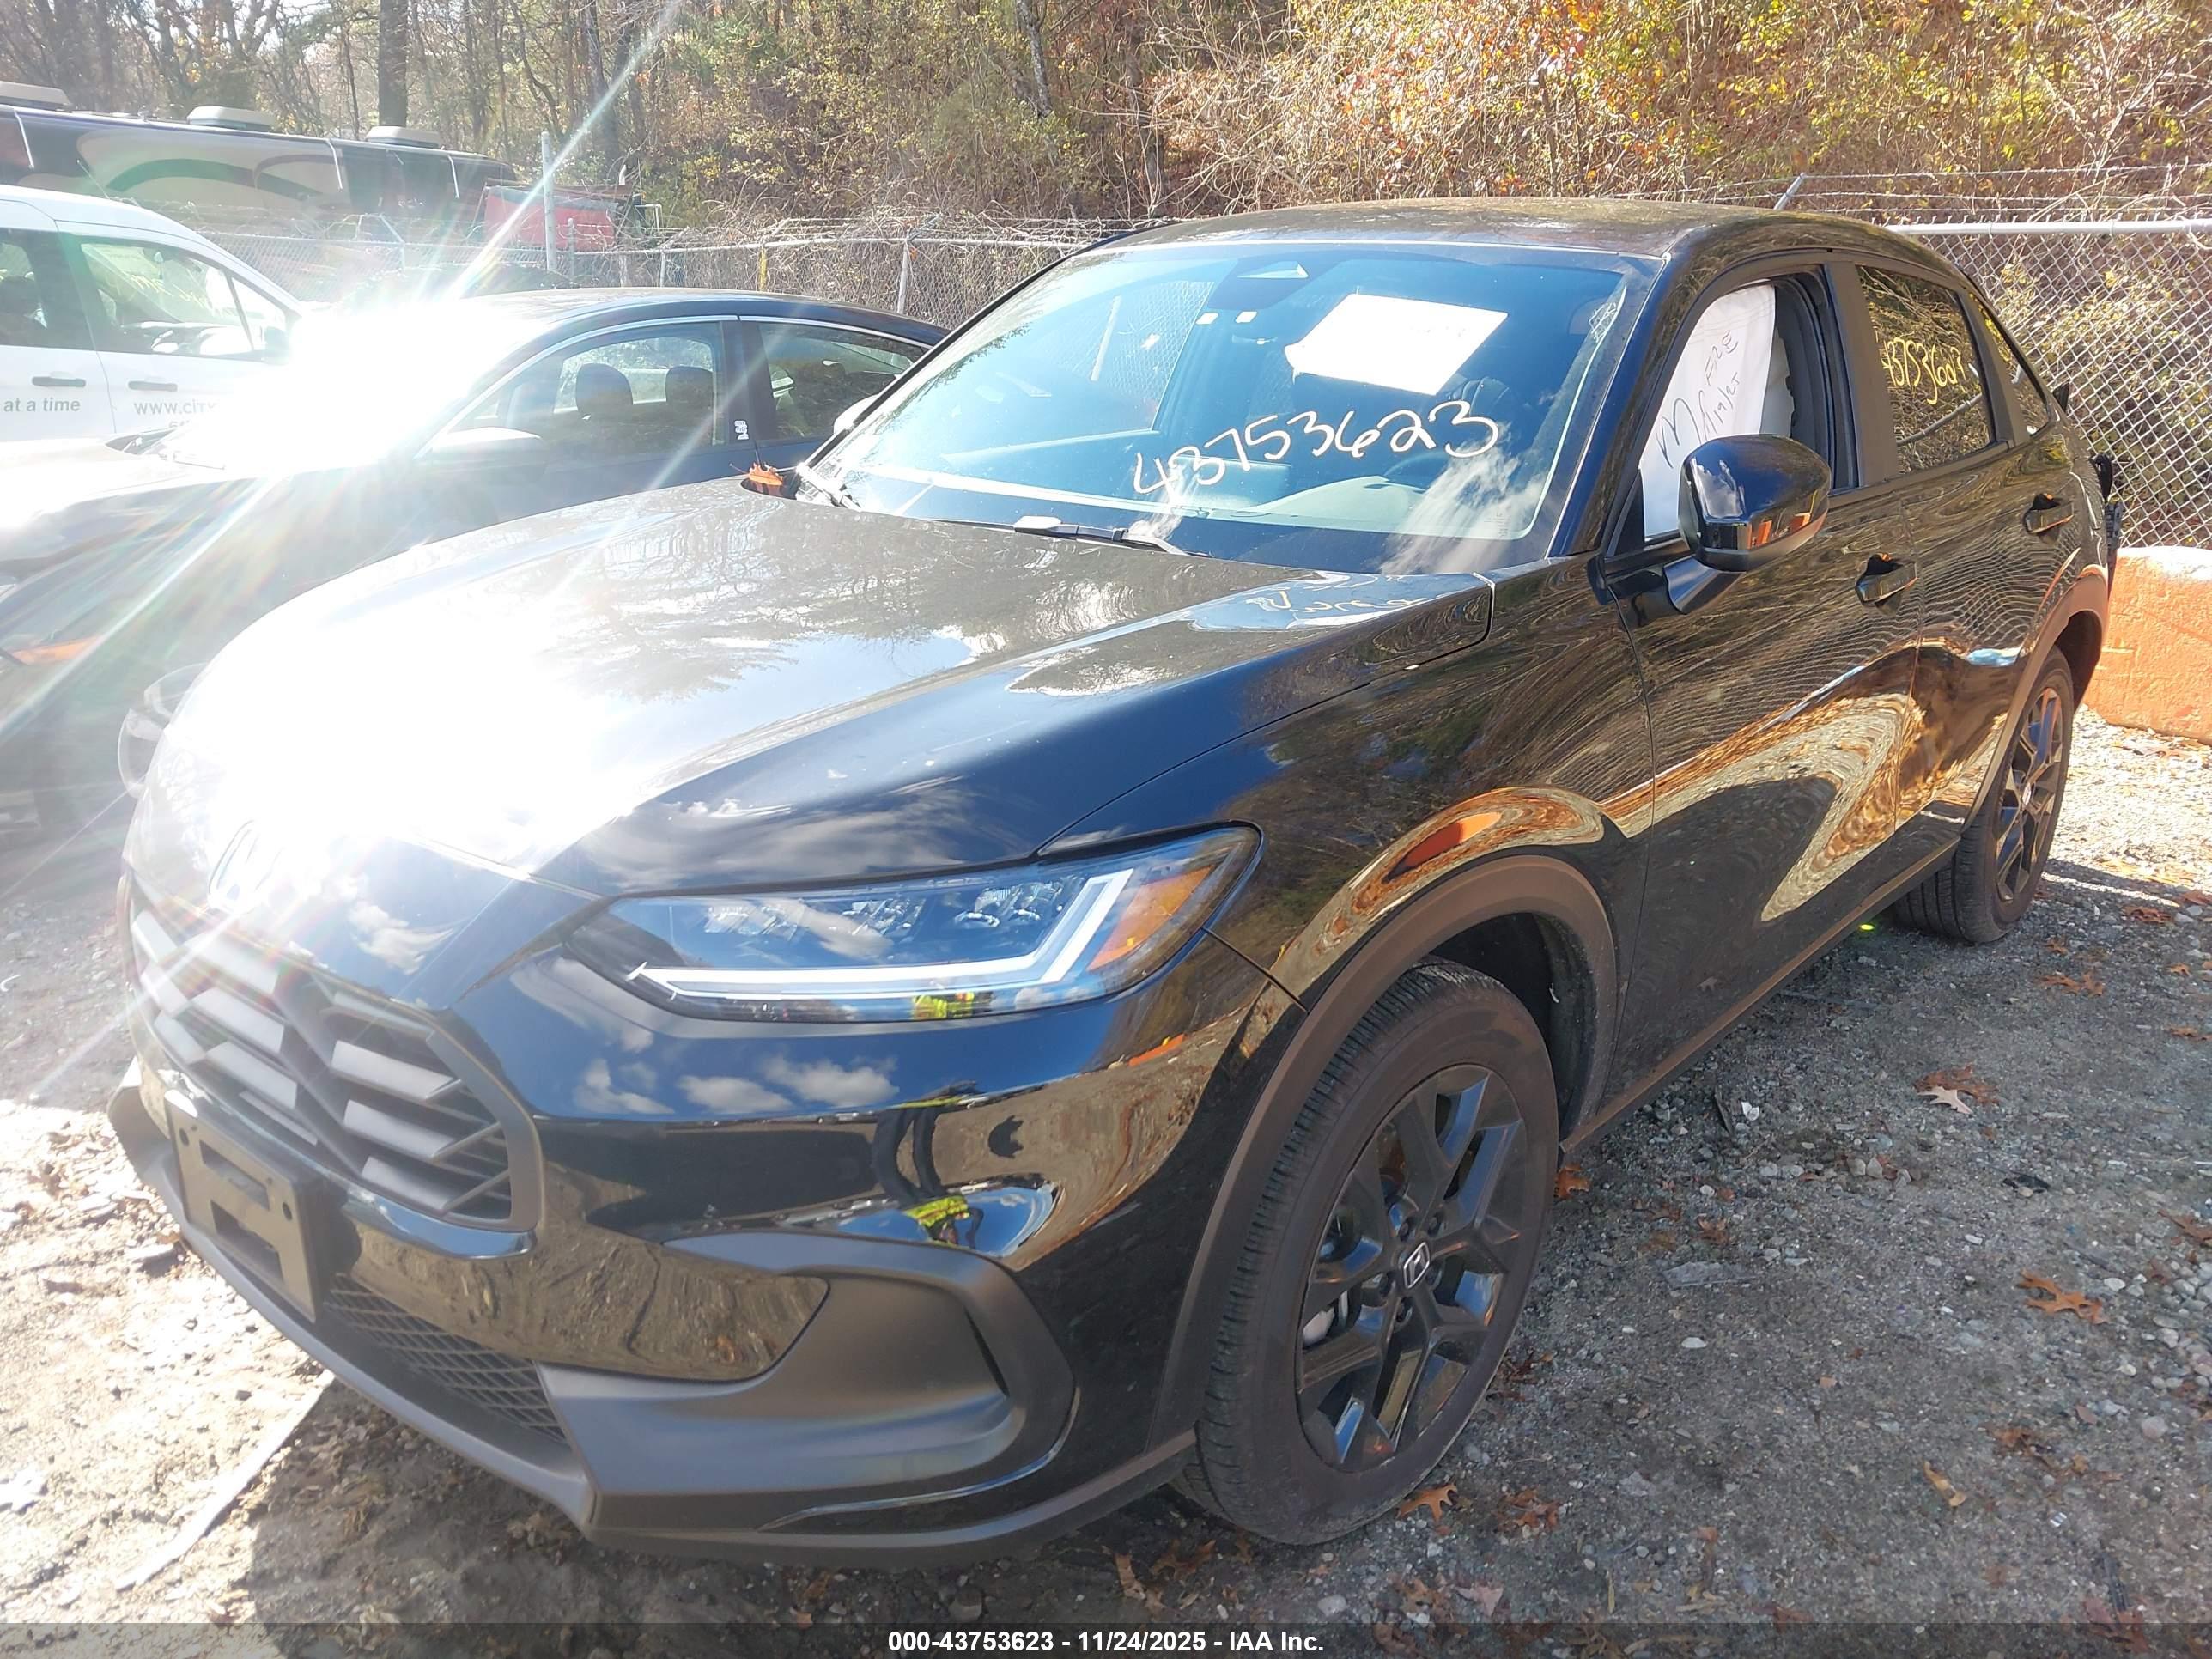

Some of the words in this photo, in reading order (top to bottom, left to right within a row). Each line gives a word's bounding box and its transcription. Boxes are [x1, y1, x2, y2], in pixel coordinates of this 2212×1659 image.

[3, 398, 21, 412] at
[27, 400, 36, 412] a
[43, 397, 81, 411] time
[1133, 400, 1499, 497] 43753623
